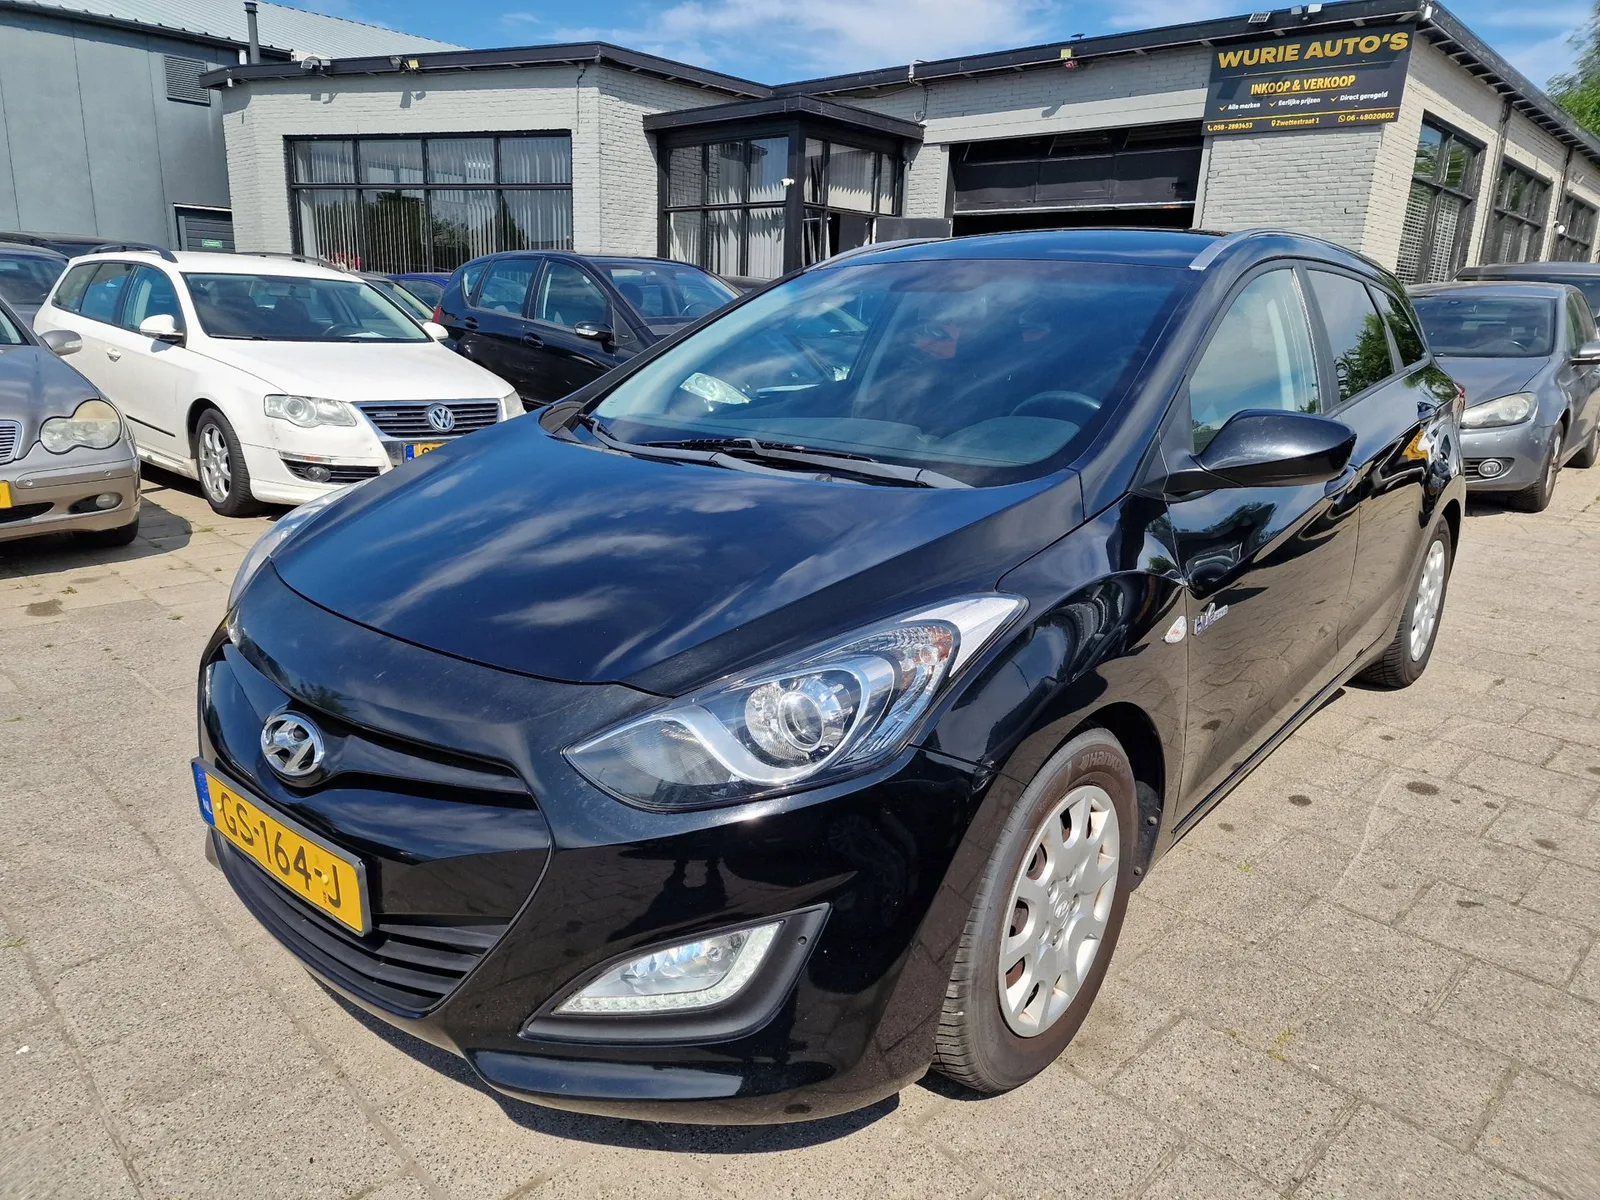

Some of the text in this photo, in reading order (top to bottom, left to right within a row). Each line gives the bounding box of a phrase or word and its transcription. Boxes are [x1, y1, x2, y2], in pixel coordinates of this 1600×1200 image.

[1218, 32, 1409, 69] WURIE AUTO'S
[1251, 75, 1356, 95] INKOOP & VERKOOP
[1278, 97, 1321, 107] Eerlijke prijzen
[1340, 91, 1389, 101] Direct geregeld
[221, 792, 341, 908] GS-164-J
